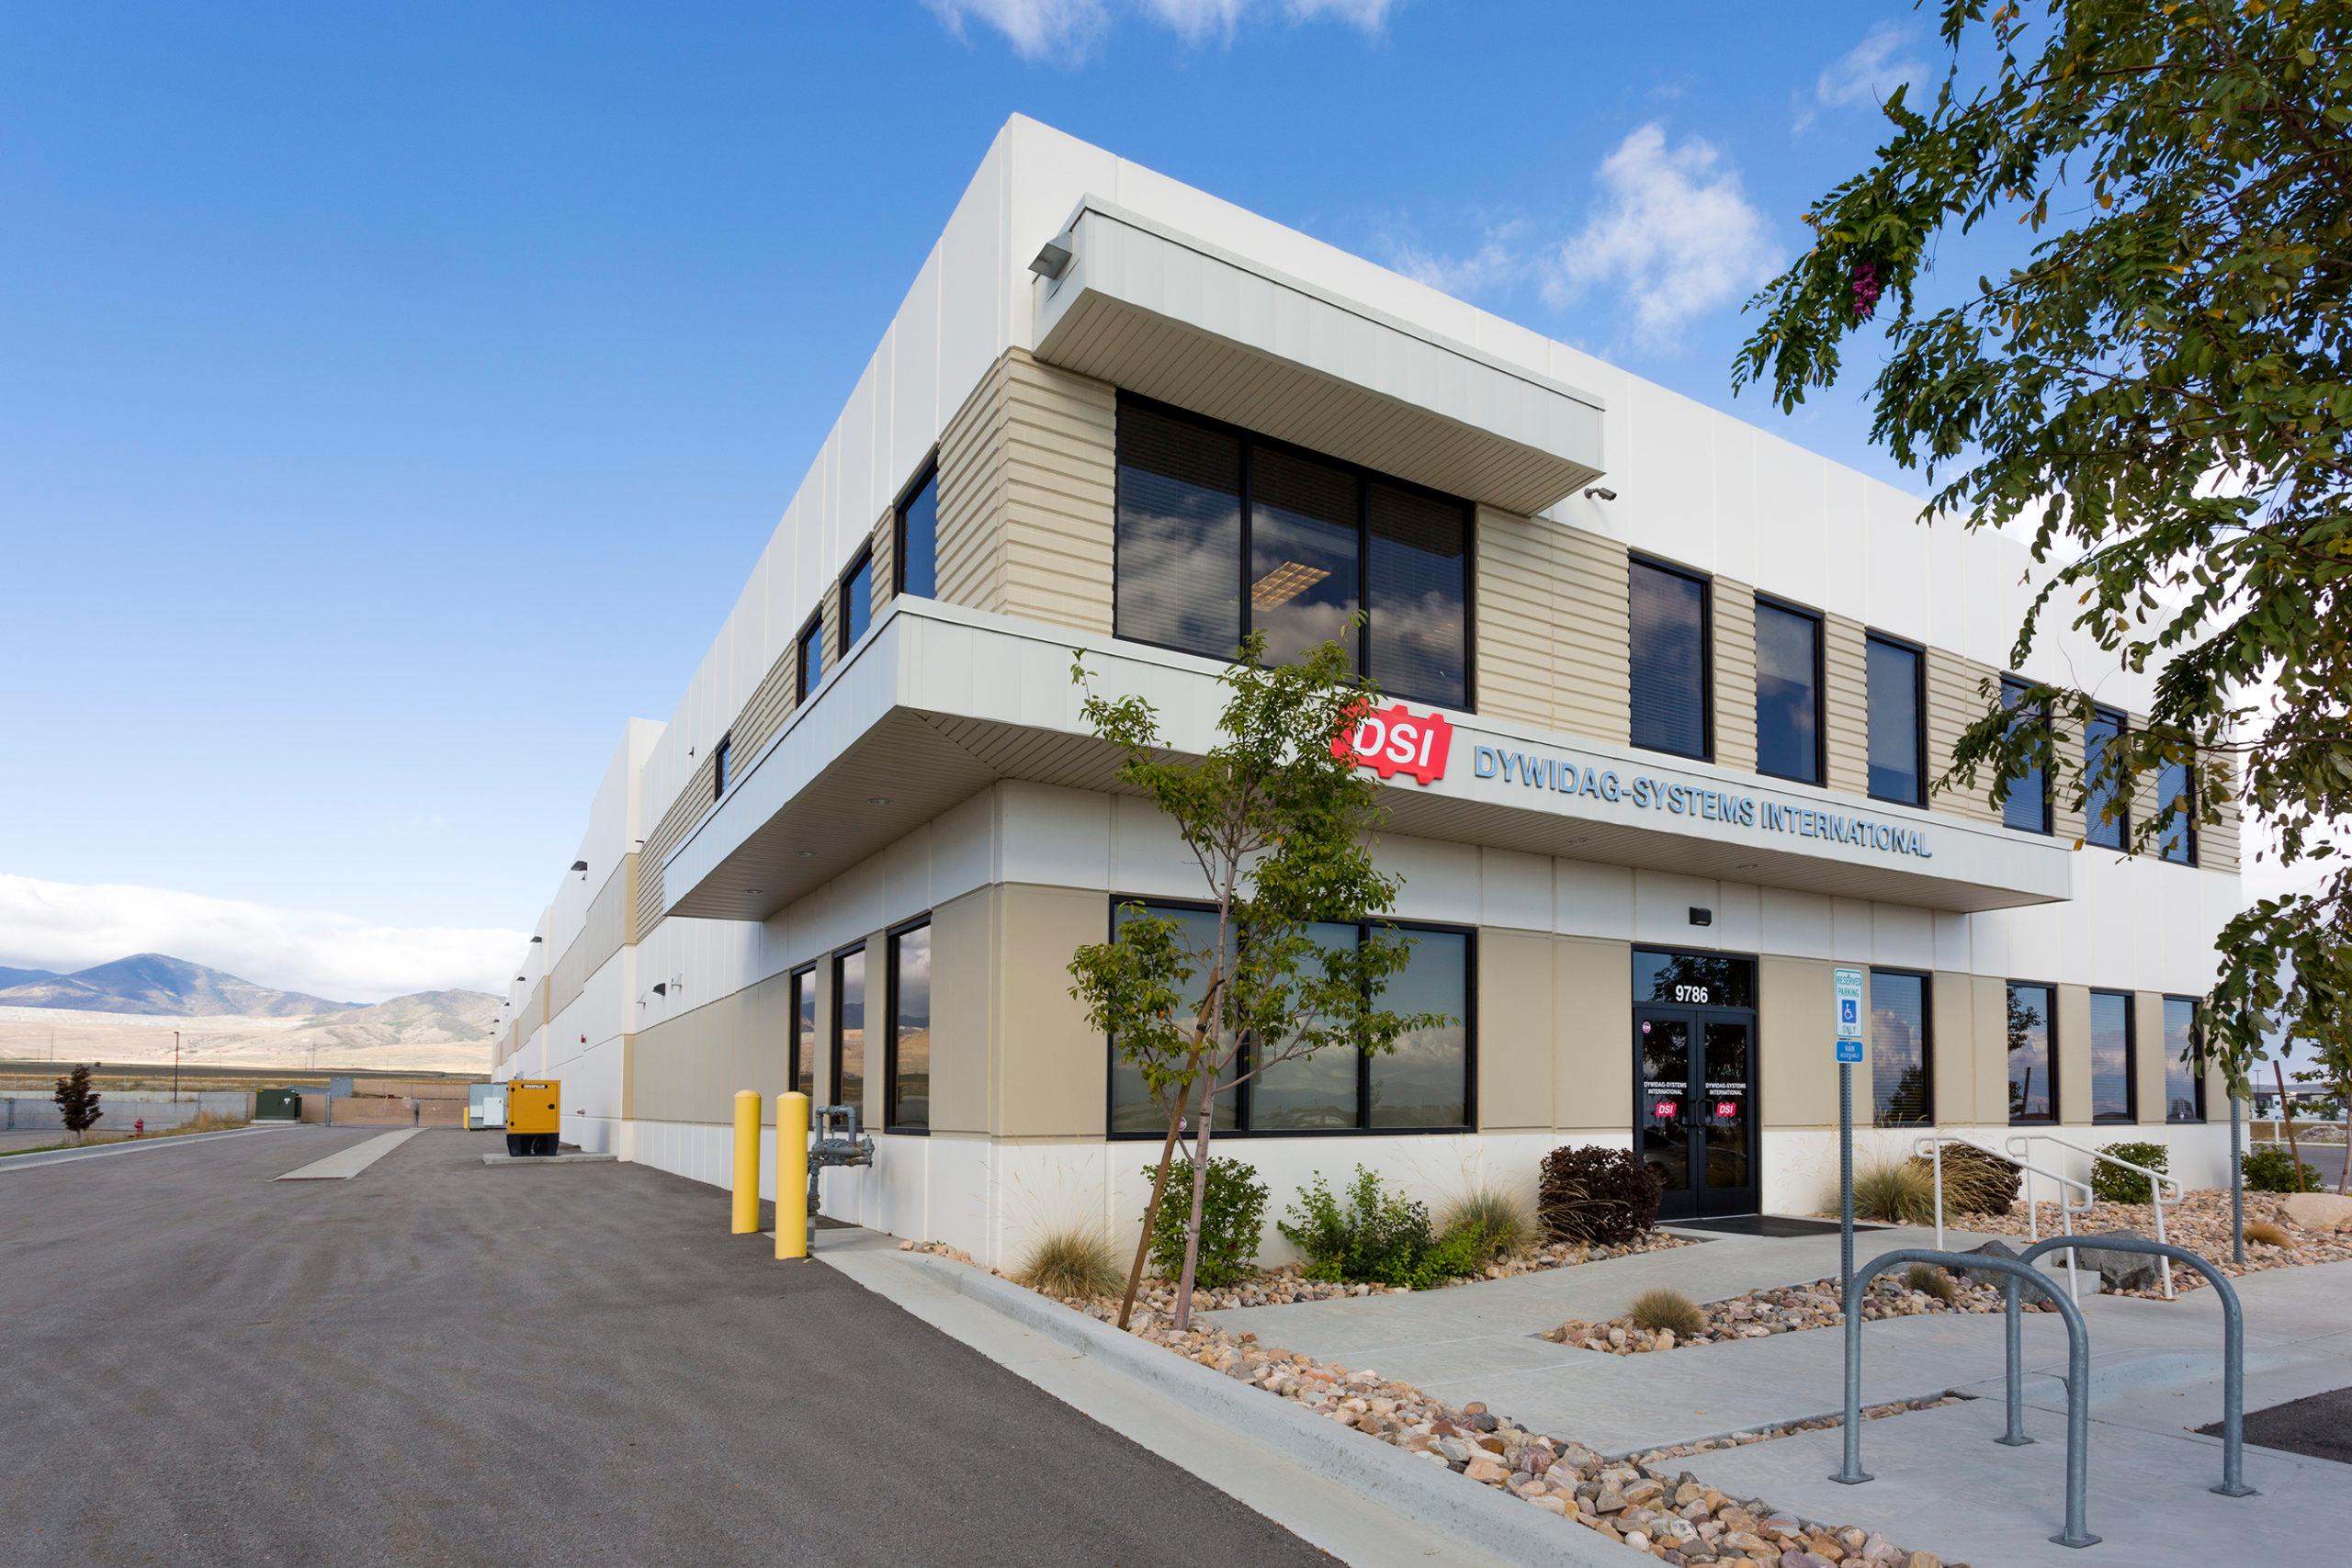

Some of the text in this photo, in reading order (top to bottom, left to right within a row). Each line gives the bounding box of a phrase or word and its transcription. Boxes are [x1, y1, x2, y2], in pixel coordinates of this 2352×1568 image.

[1351, 716, 1435, 767] DSI
[1475, 745, 1932, 858] DYWIDAG-SYSTEMS INTERNATIONAL
[1675, 985, 1709, 1003] 9786
[1838, 987, 1860, 998] PARKING
[1658, 1105, 1673, 1114] DSI
[1719, 1105, 1734, 1114] DSI
